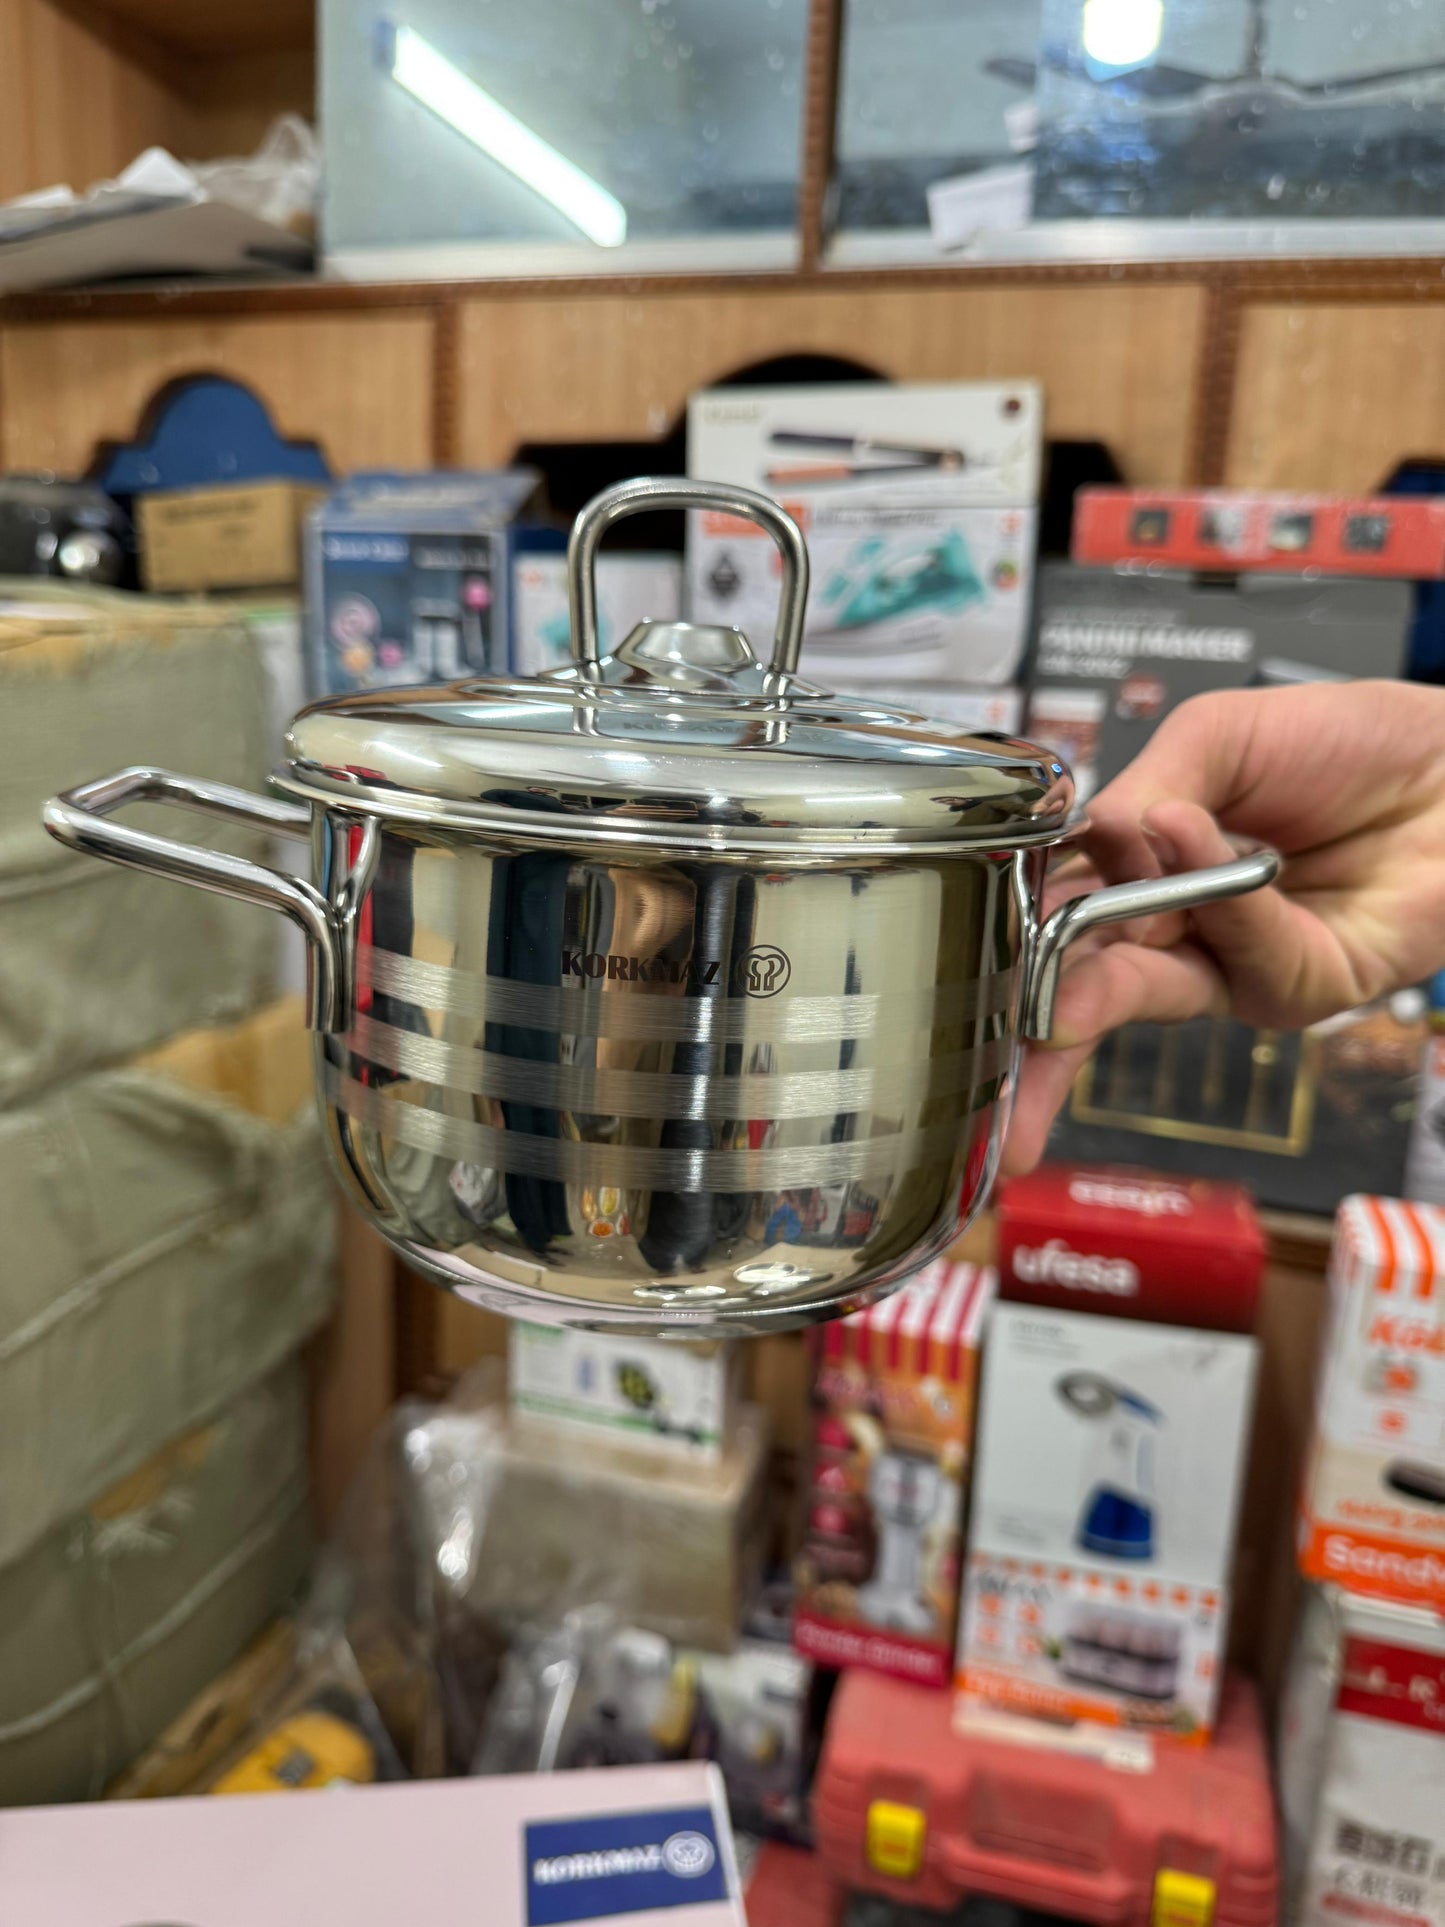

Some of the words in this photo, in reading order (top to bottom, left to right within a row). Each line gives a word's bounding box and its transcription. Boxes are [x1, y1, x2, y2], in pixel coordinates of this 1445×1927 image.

[561, 950, 721, 986] KORKMAZ
[1013, 1239, 1139, 1297] ufesa
[534, 1844, 662, 1885] KORKMAZ
